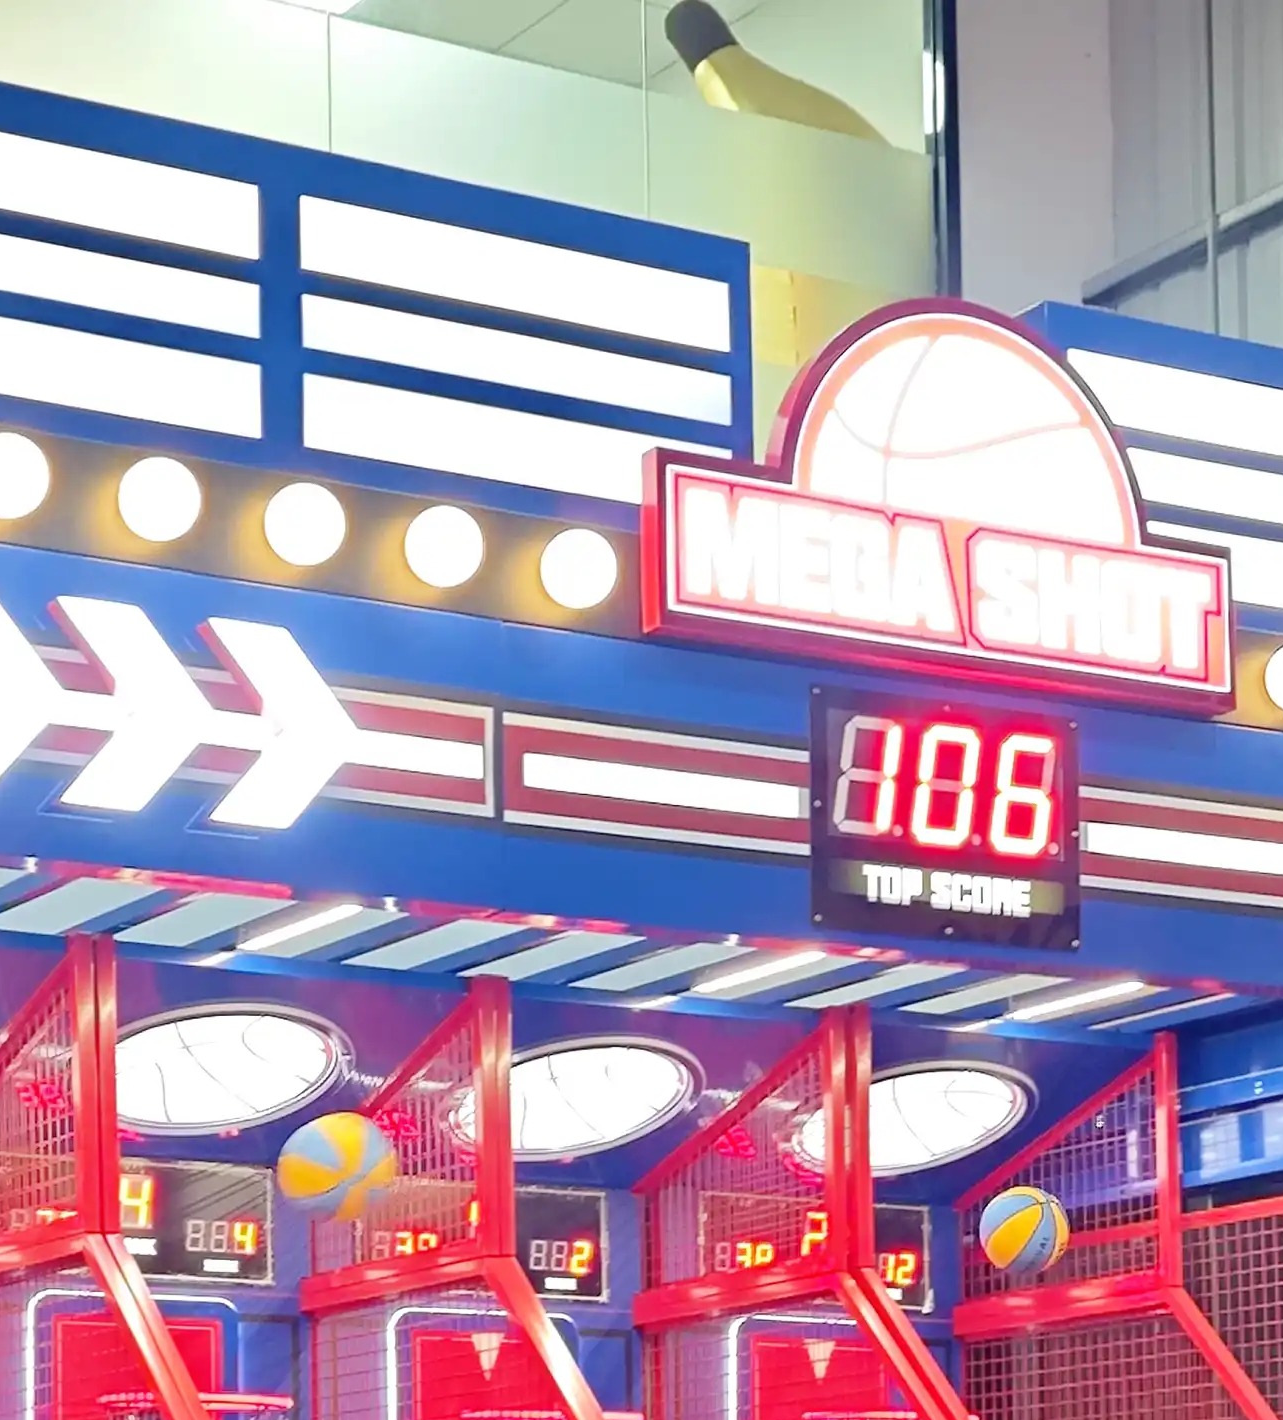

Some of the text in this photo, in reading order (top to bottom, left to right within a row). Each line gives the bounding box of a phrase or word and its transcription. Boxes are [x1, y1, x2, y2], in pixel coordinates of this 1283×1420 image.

[682, 486, 1213, 670] MEGA SHOT
[874, 723, 1055, 857] 106
[861, 863, 1032, 918] TOP SCORE
[119, 1175, 153, 1228] 4
[233, 1220, 256, 1255] 4
[569, 1240, 593, 1275] 2
[885, 1252, 916, 1287] 12
